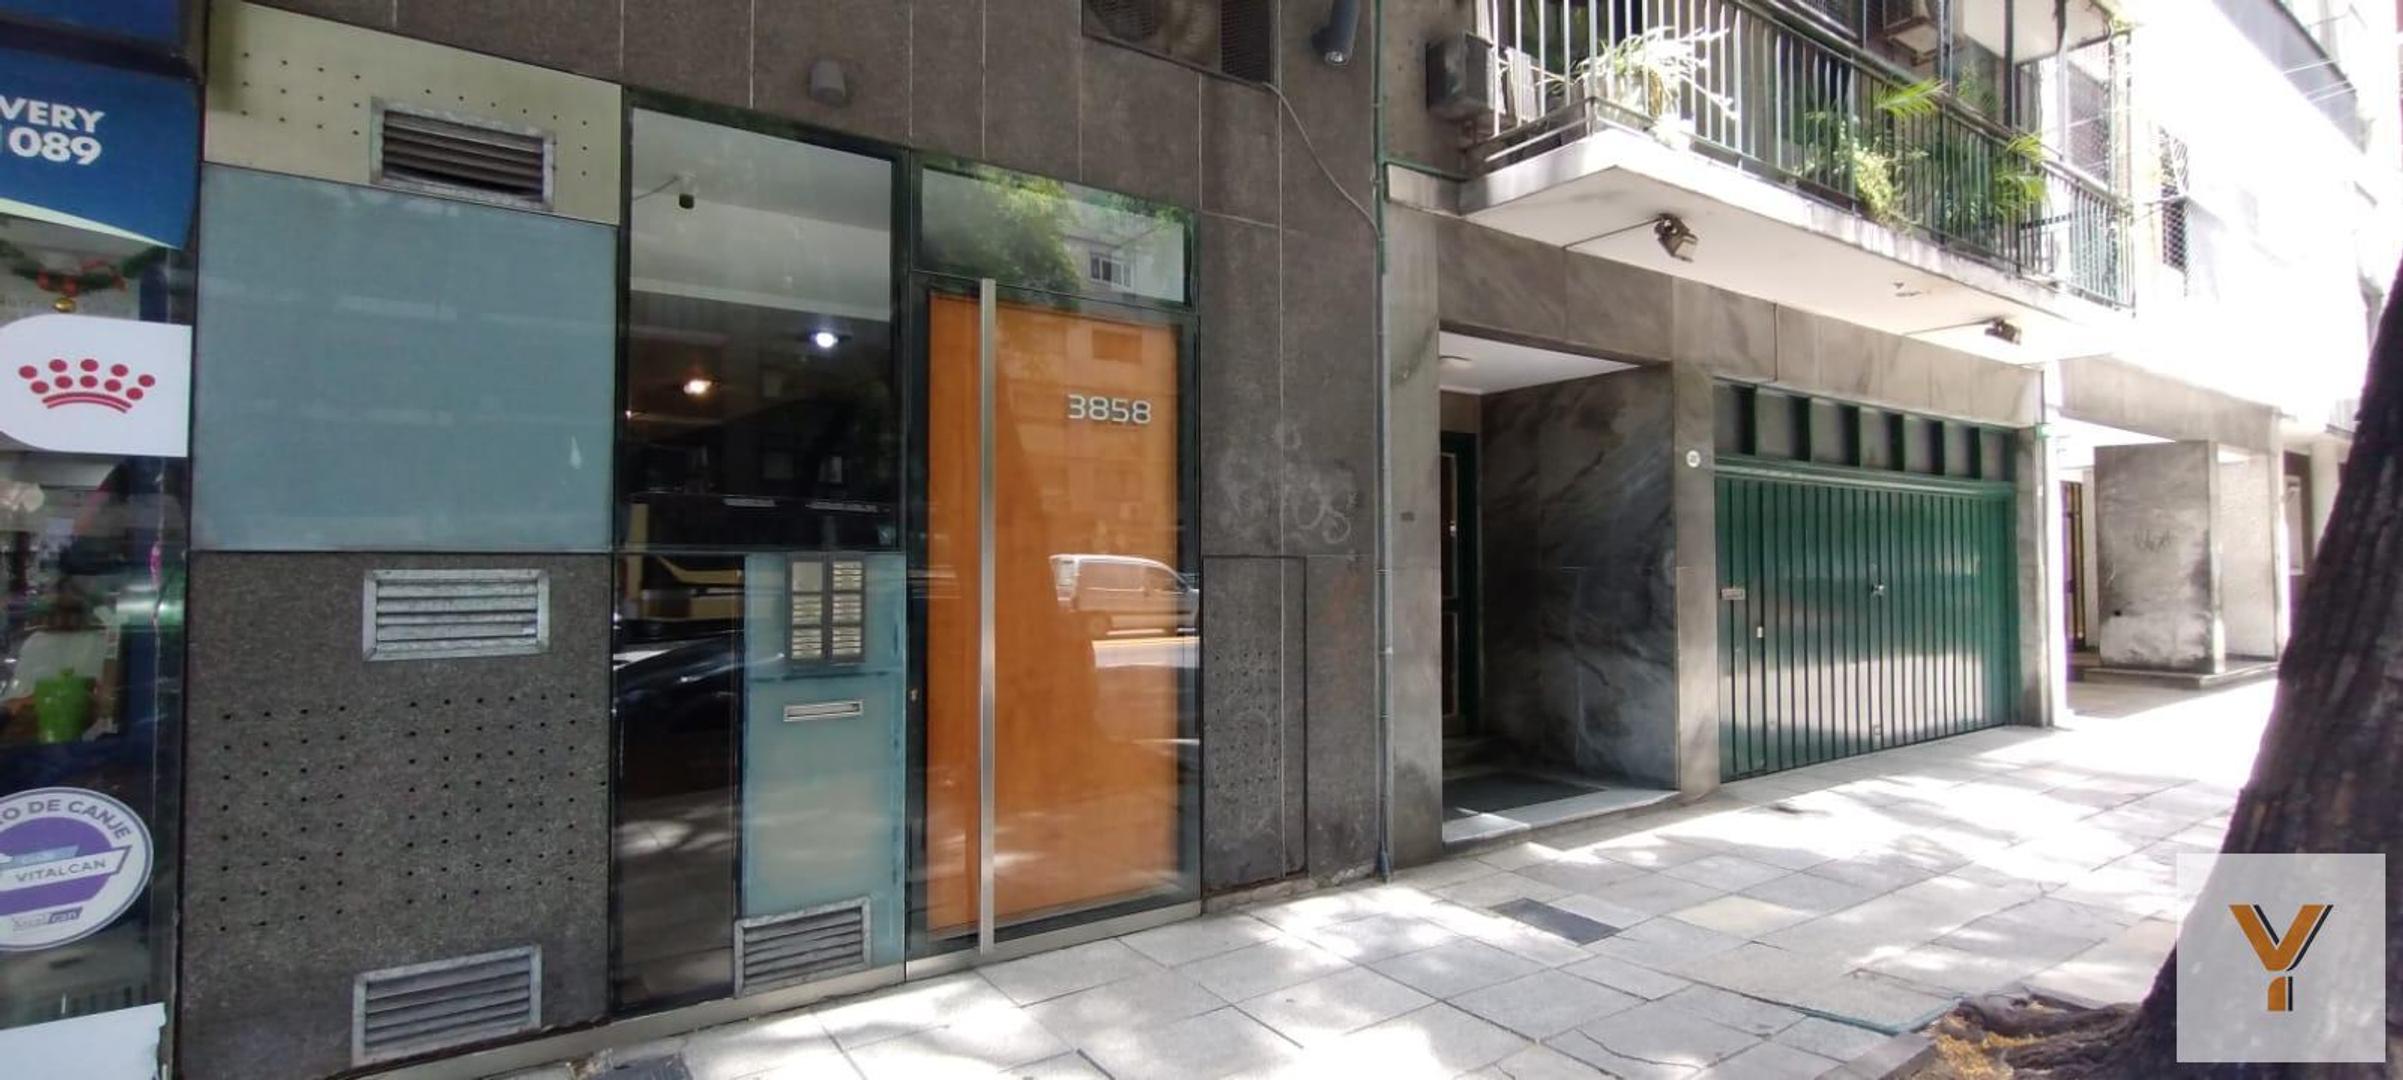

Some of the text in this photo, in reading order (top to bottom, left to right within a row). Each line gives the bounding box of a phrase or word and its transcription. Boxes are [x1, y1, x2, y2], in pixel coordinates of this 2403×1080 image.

[0, 124, 102, 165] 089
[1068, 393, 1152, 424] 3858
[27, 799, 61, 814] DE
[67, 800, 131, 840] CANJE
[15, 858, 106, 883] VITALCAN
